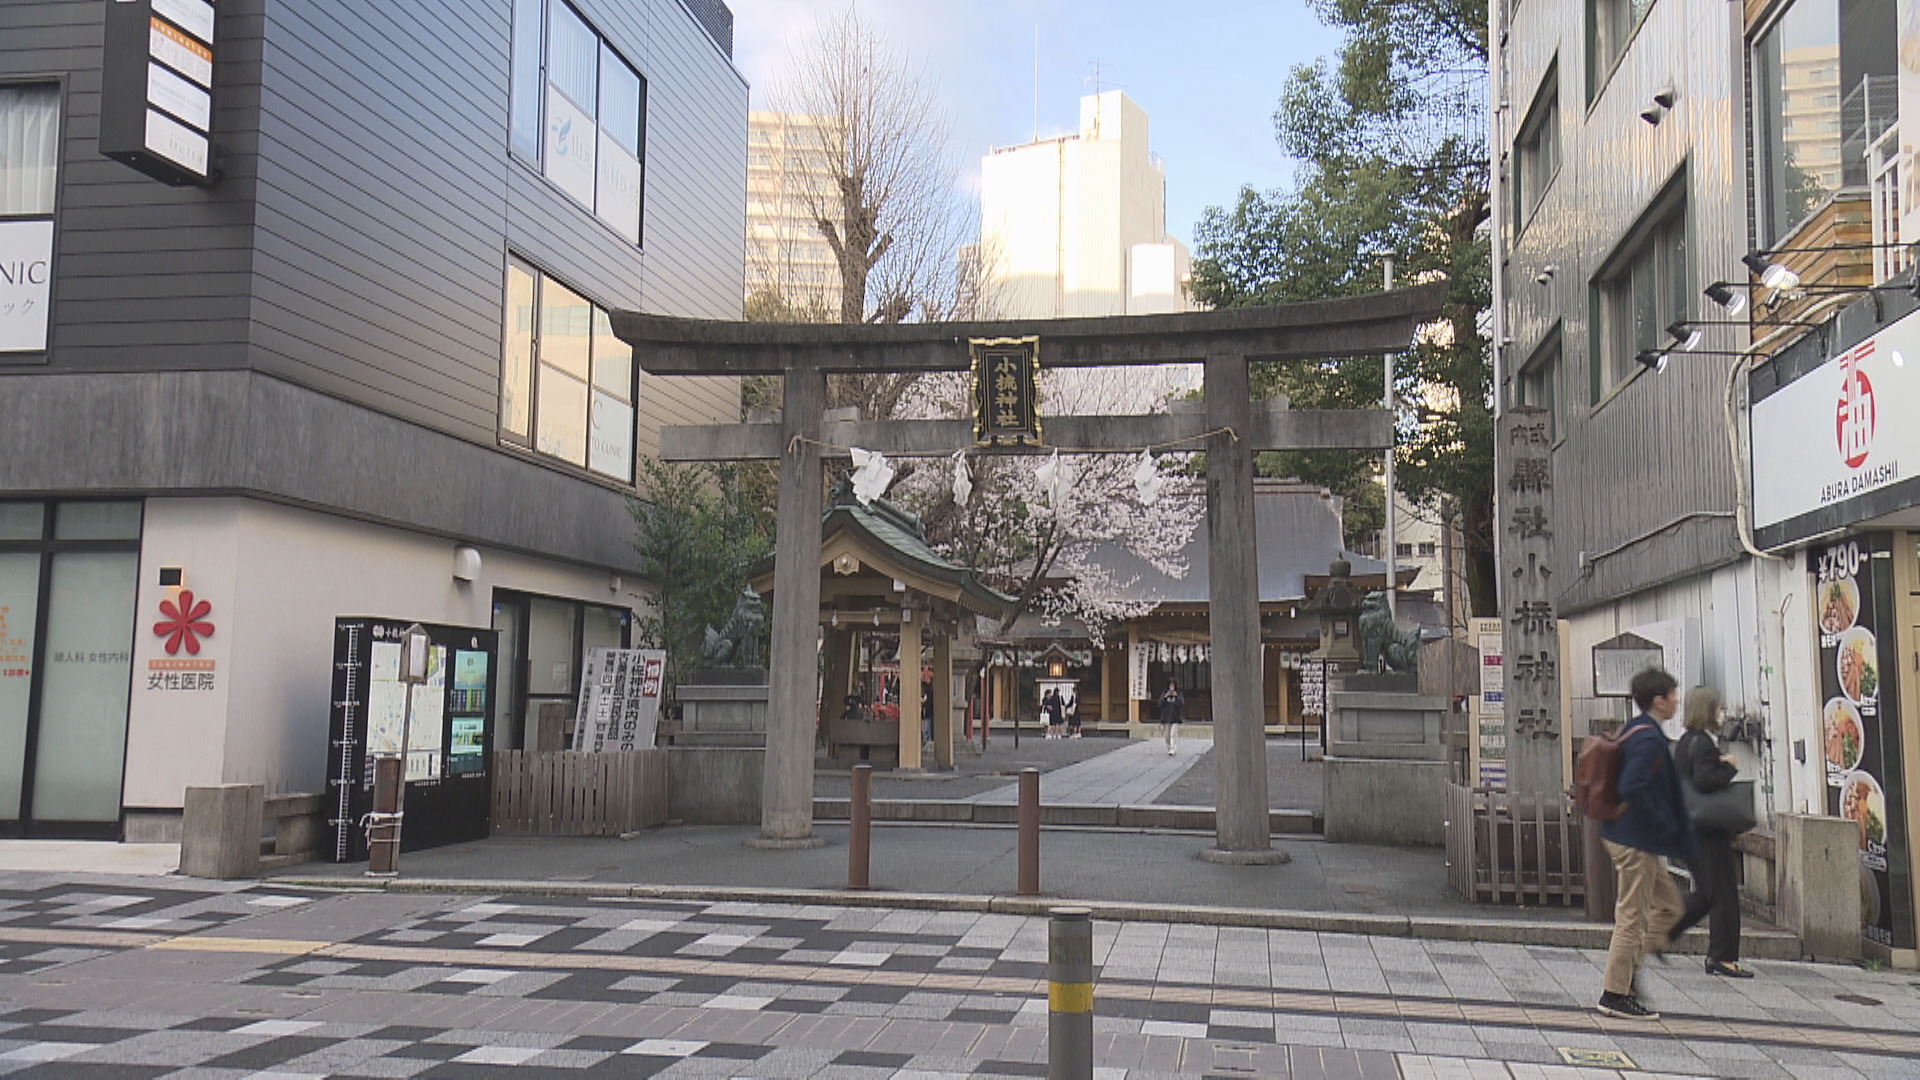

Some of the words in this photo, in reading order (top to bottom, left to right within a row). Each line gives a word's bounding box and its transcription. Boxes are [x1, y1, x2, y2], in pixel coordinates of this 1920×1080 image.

[994, 356, 1020, 427] 小梳神社
[1820, 479, 1849, 503] ABURA
[1851, 461, 1898, 492] DAMASHII
[147, 672, 215, 690] 女性医院
